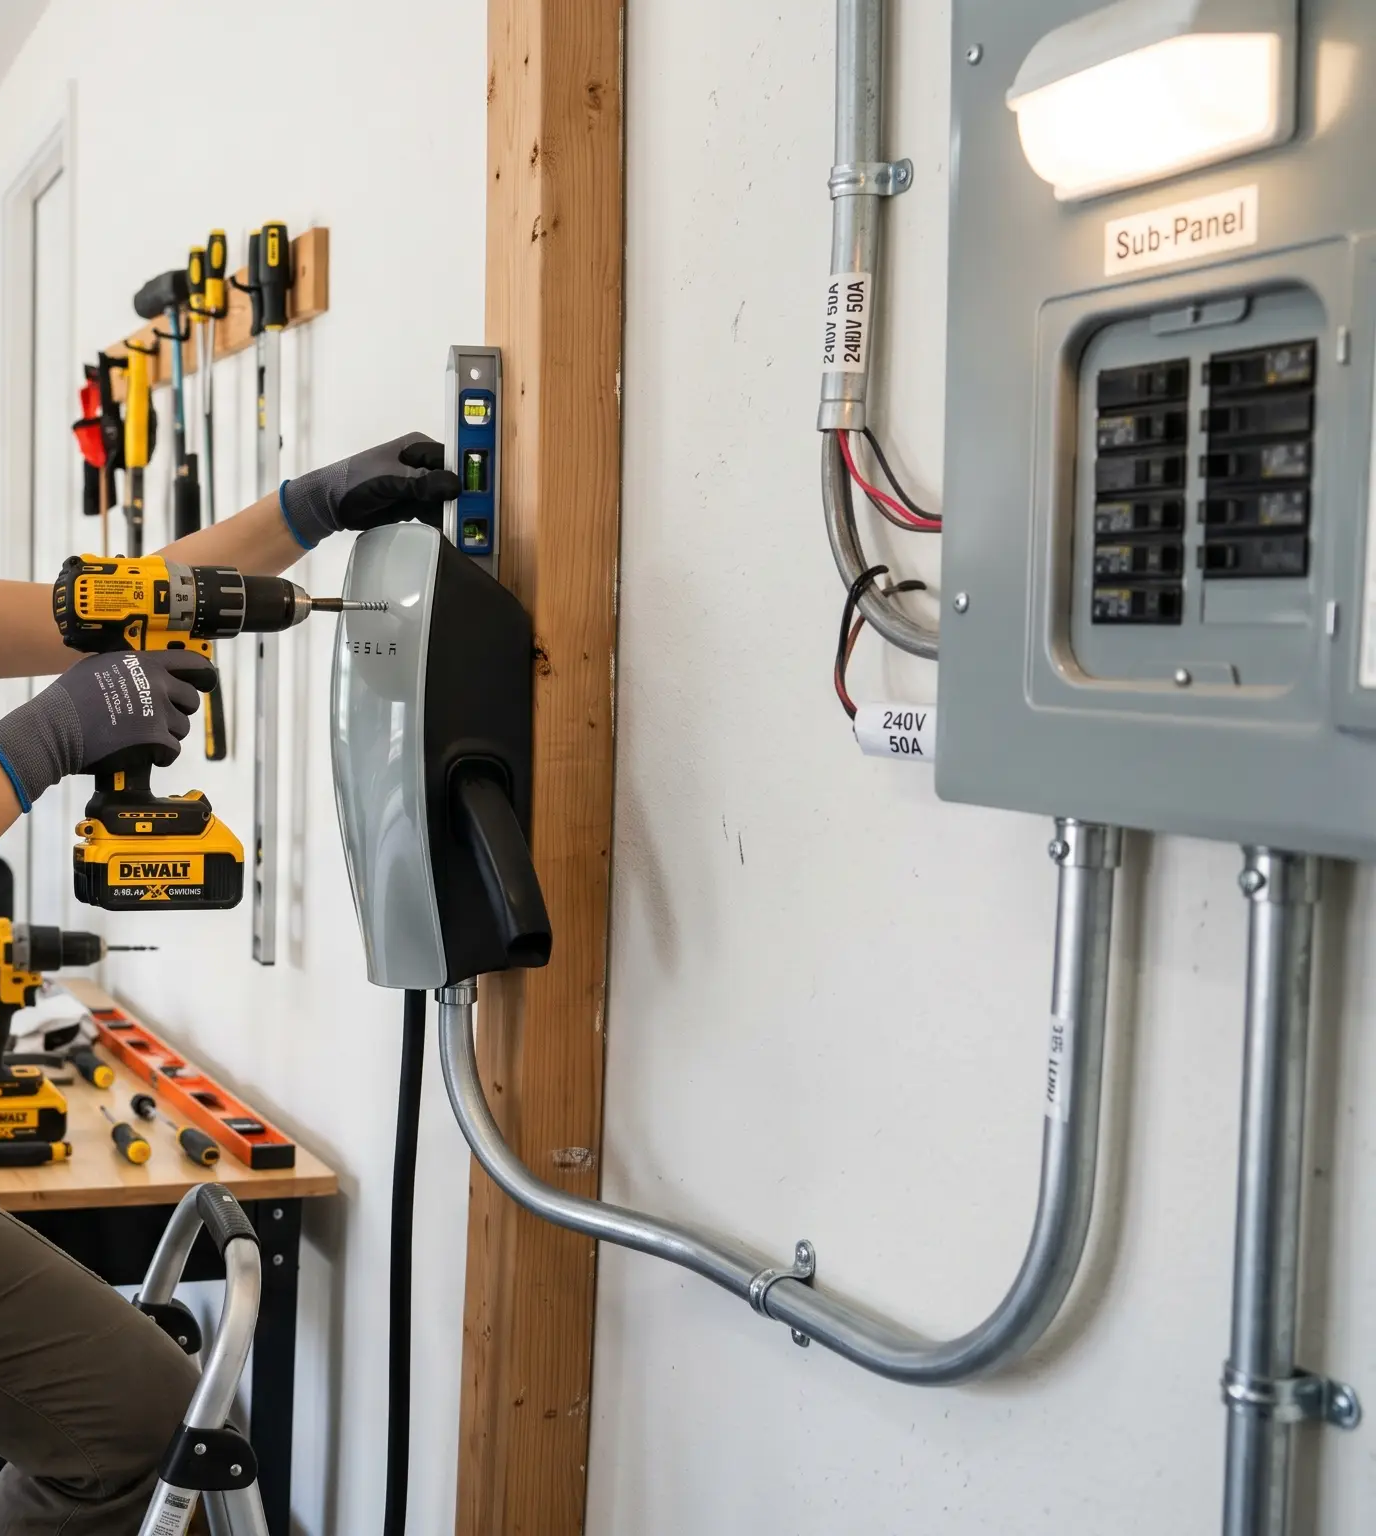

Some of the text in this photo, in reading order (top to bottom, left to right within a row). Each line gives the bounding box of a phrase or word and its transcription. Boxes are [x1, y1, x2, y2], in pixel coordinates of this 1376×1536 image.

[1116, 201, 1244, 259] Sub-Panel
[846, 281, 865, 313] 50A
[882, 711, 927, 732] 240V
[889, 735, 924, 756] 50A
